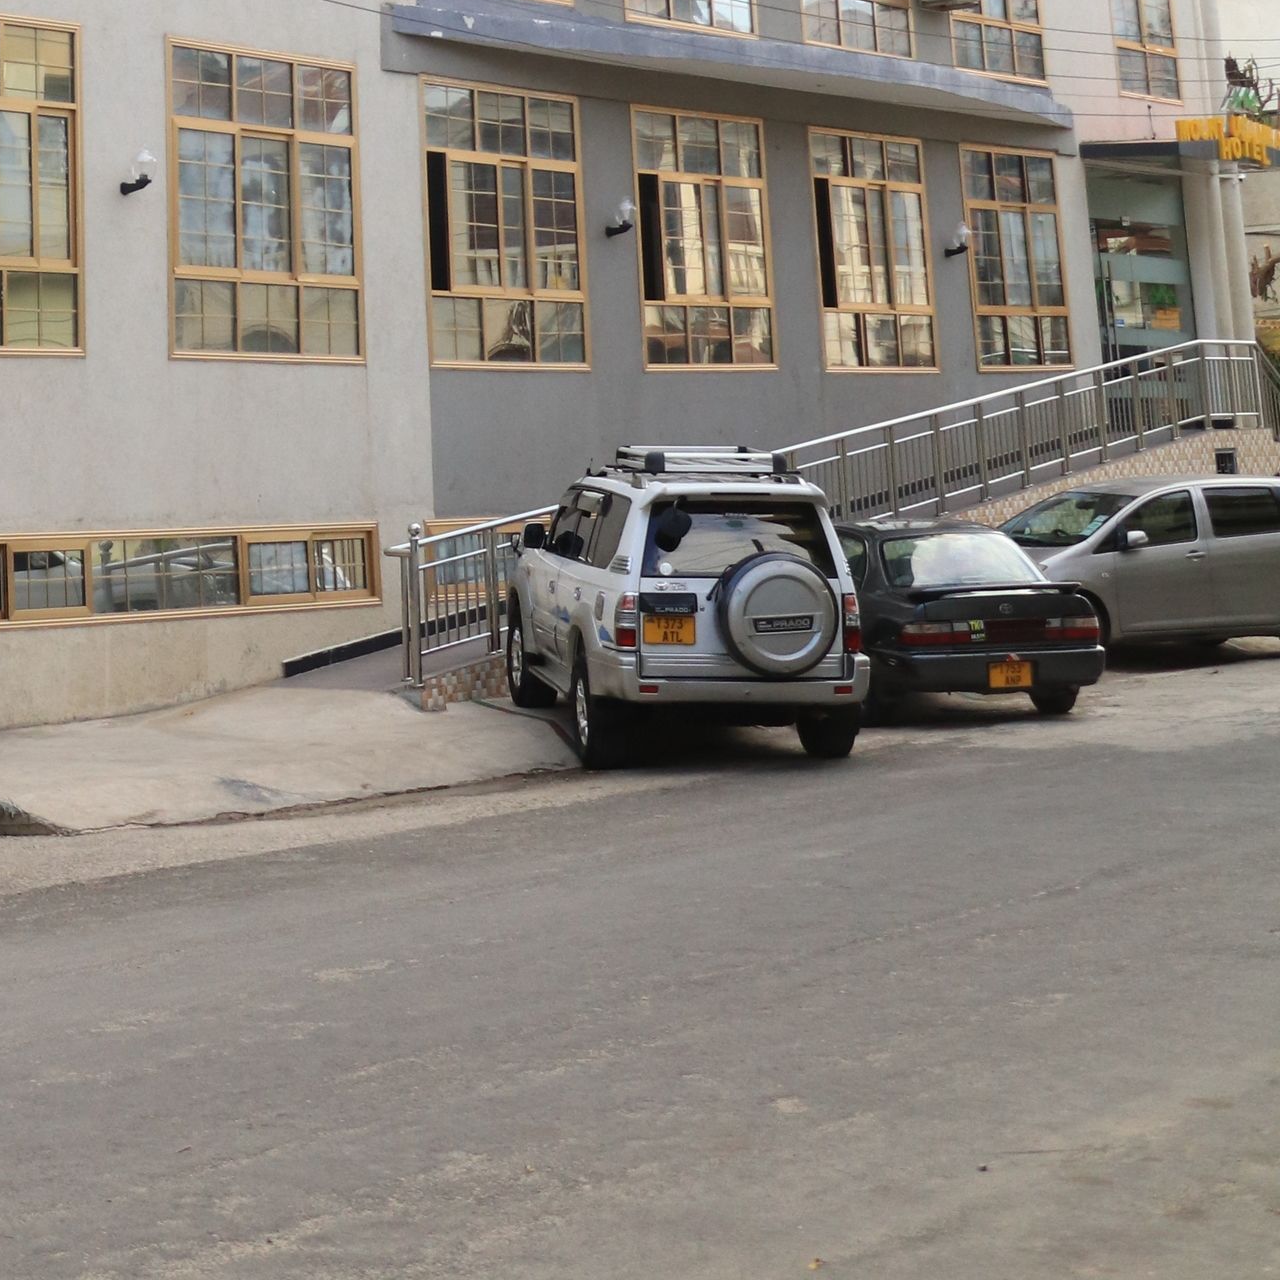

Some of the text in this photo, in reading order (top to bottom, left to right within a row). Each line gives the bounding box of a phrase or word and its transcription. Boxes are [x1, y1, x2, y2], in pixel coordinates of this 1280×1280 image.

[1220, 137, 1271, 167] HOTEL
[772, 618, 810, 628] PRADO
[662, 630, 682, 643] ATL
